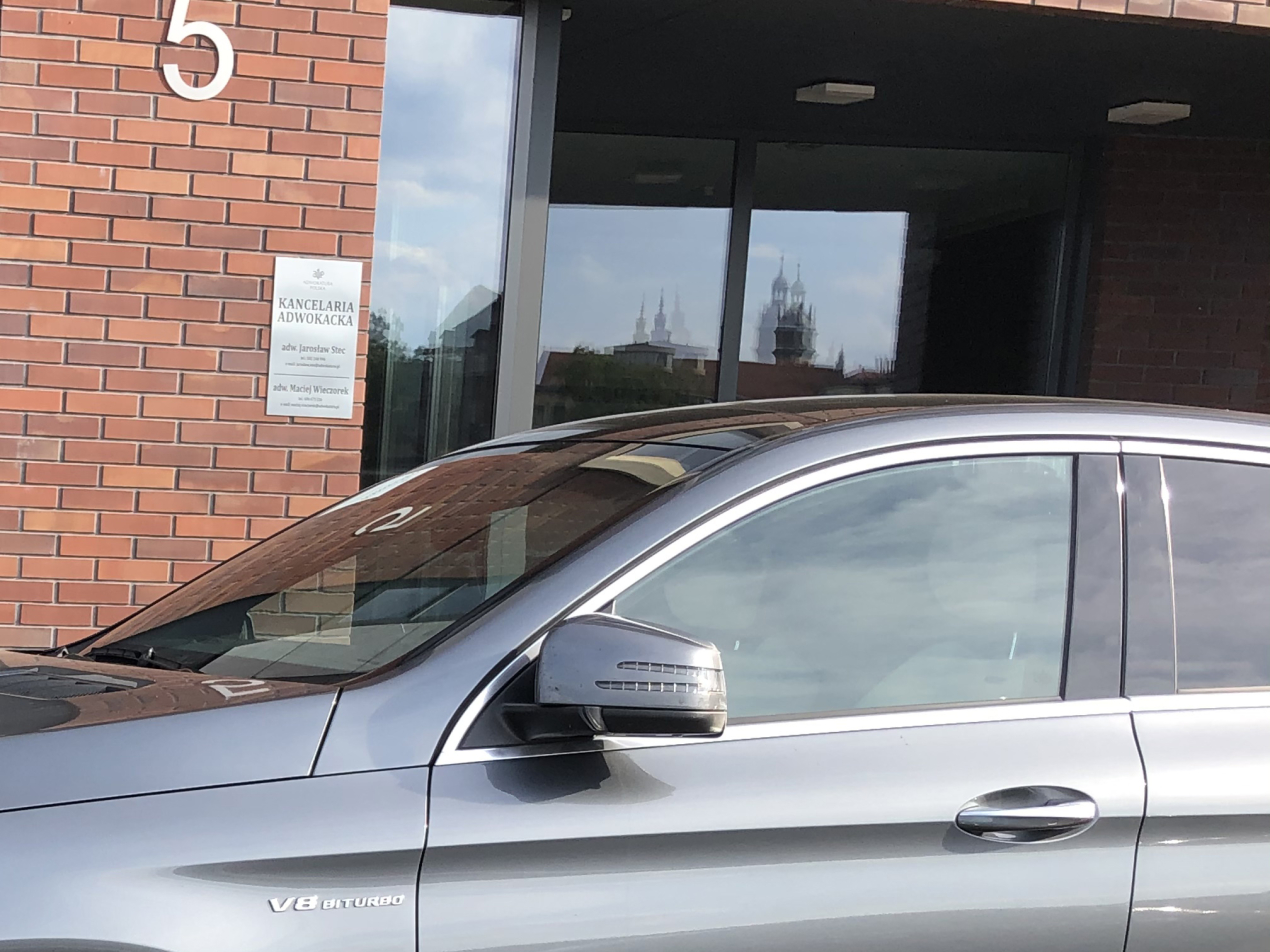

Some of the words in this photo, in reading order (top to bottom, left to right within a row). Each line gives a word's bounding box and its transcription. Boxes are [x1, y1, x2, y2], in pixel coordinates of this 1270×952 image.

[163, 0, 234, 100] 5
[278, 297, 354, 313] KANCELARIA
[277, 311, 354, 327] ADWOKACKA
[281, 343, 297, 351] adw.
[331, 345, 346, 355] Stec
[273, 383, 288, 392] adw.
[290, 384, 312, 395] Maciej
[313, 385, 349, 395] Wieczorek
[268, 895, 318, 912] V8
[321, 894, 405, 910] BITURBO
